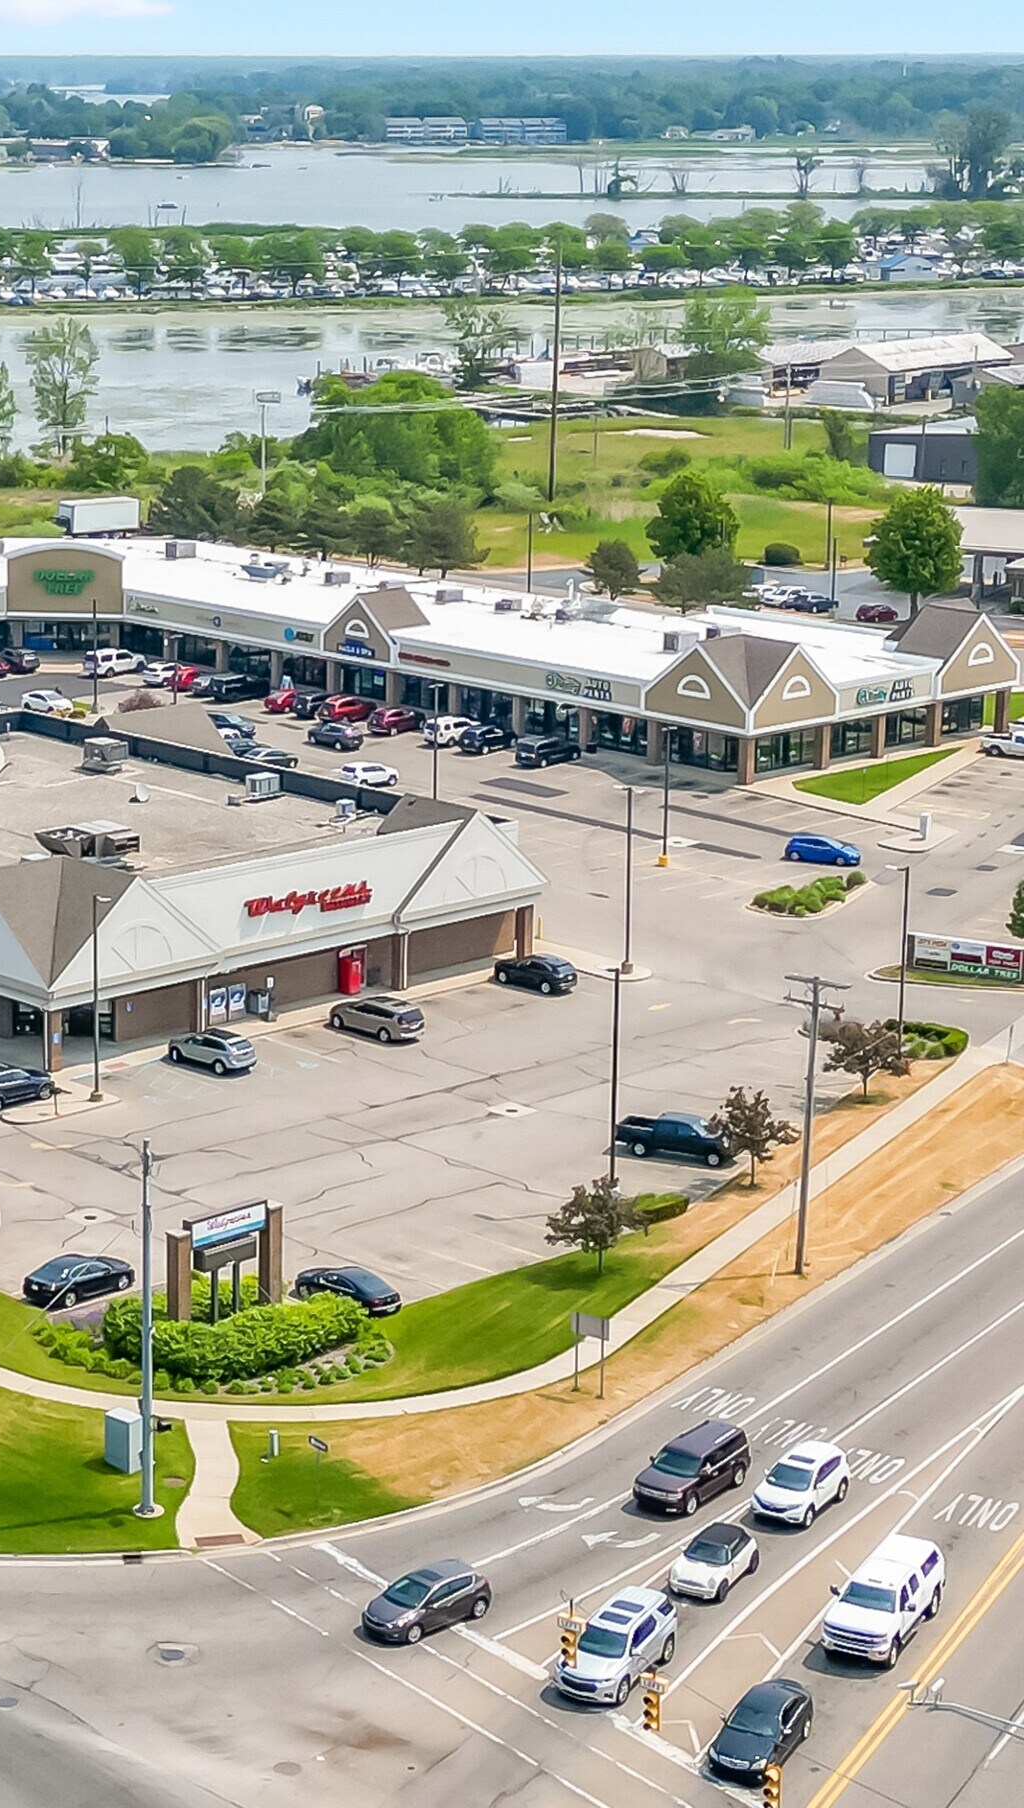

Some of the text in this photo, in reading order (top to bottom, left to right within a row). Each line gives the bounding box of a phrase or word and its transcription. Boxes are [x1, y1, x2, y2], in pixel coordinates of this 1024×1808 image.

[243, 880, 372, 917] Walgreens
[951, 963, 990, 975] DOLLAR
[994, 969, 1019, 979] TREE
[671, 1386, 756, 1419] ONLY
[933, 1493, 1020, 1531] ONLY
